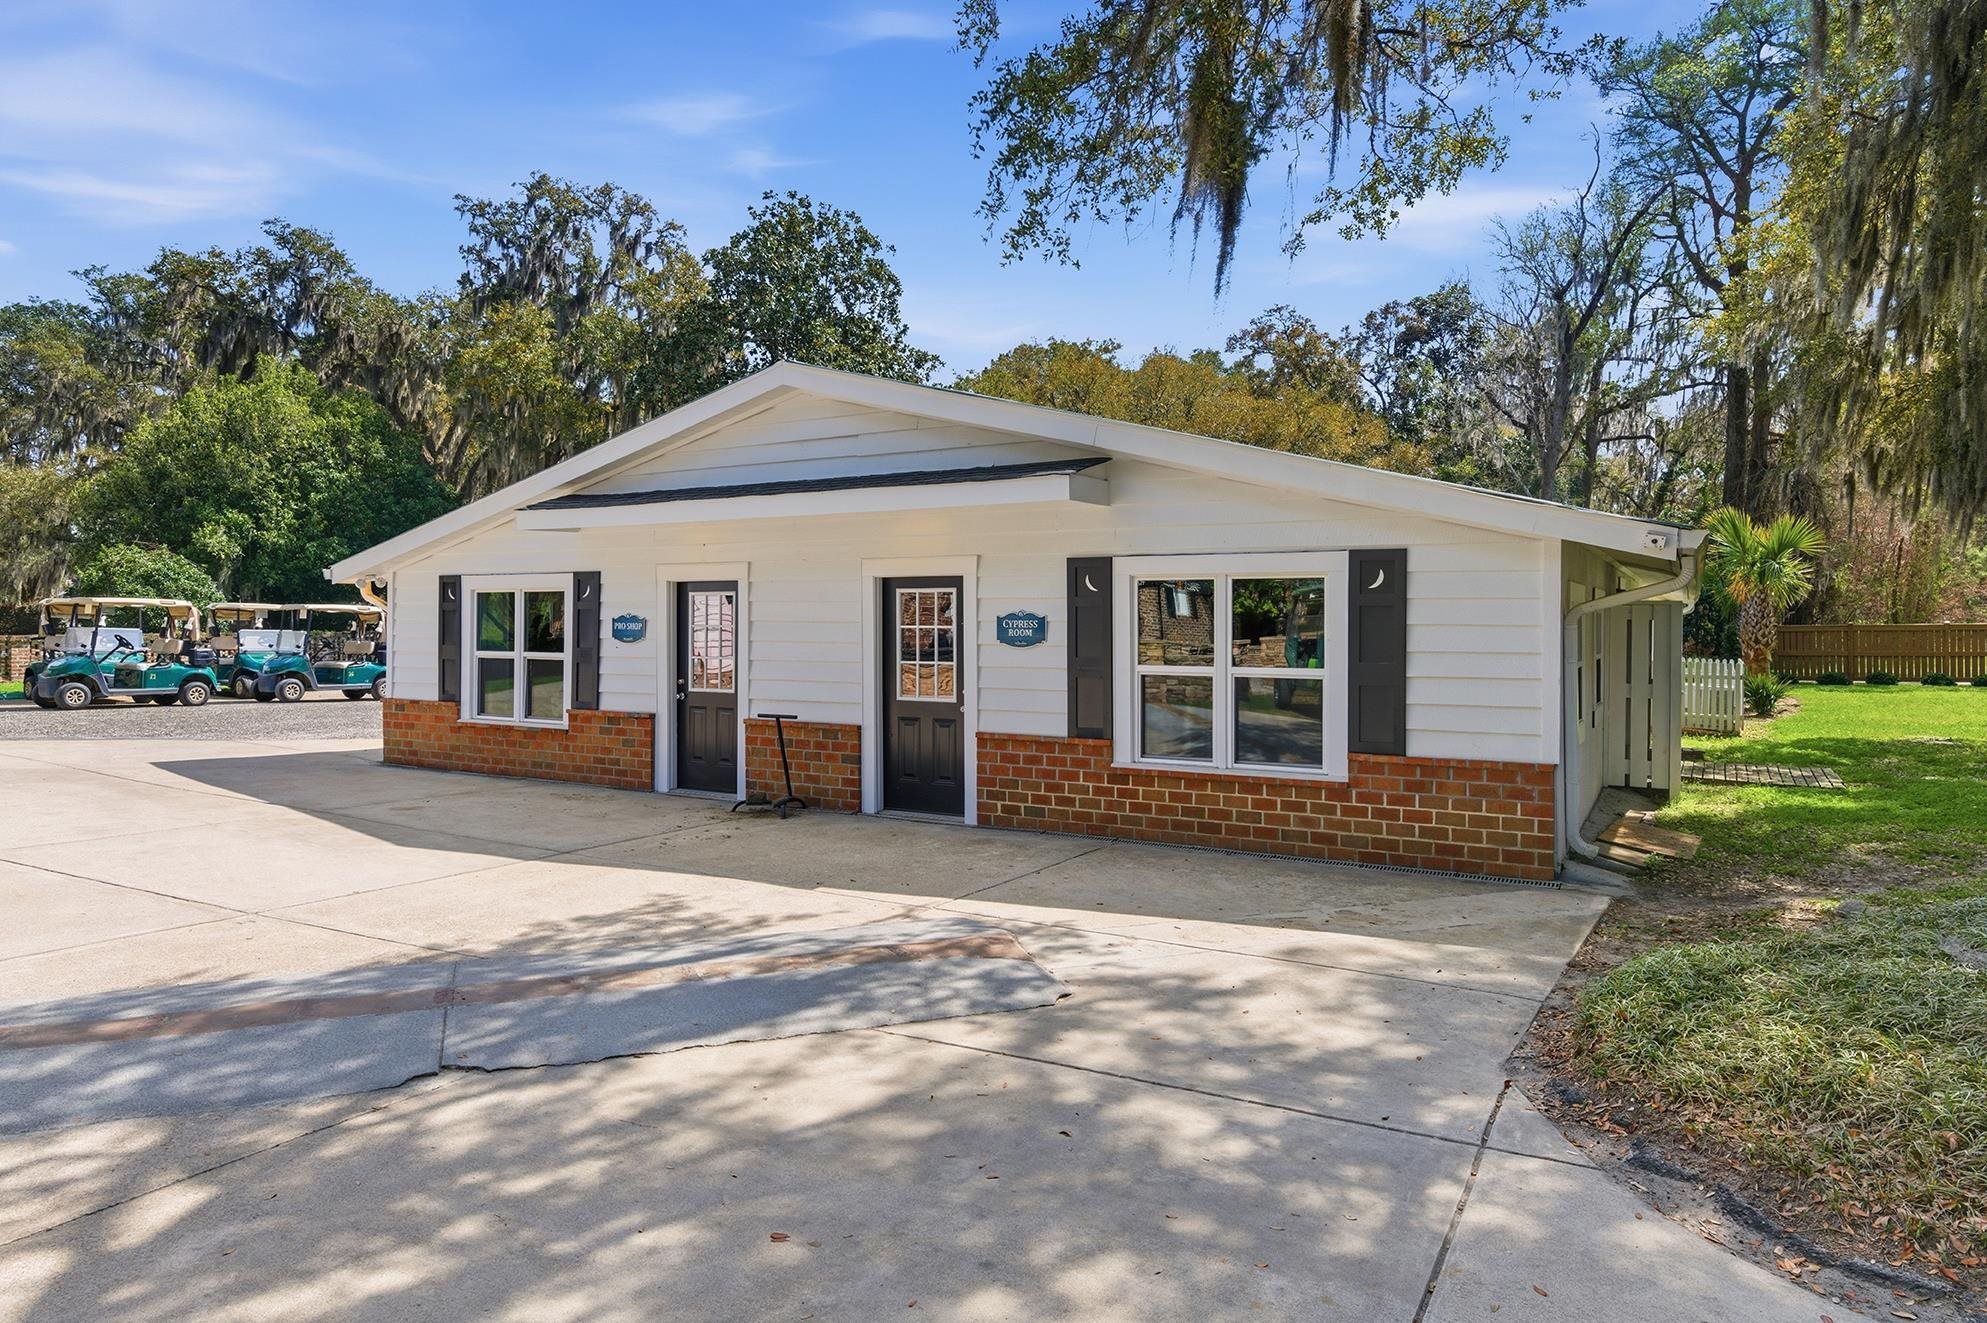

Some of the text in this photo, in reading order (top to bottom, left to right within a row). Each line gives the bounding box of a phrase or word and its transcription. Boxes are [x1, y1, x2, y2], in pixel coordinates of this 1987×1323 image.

[614, 622, 641, 630] PRO SHOP
[1003, 620, 1038, 628] CYPRESS
